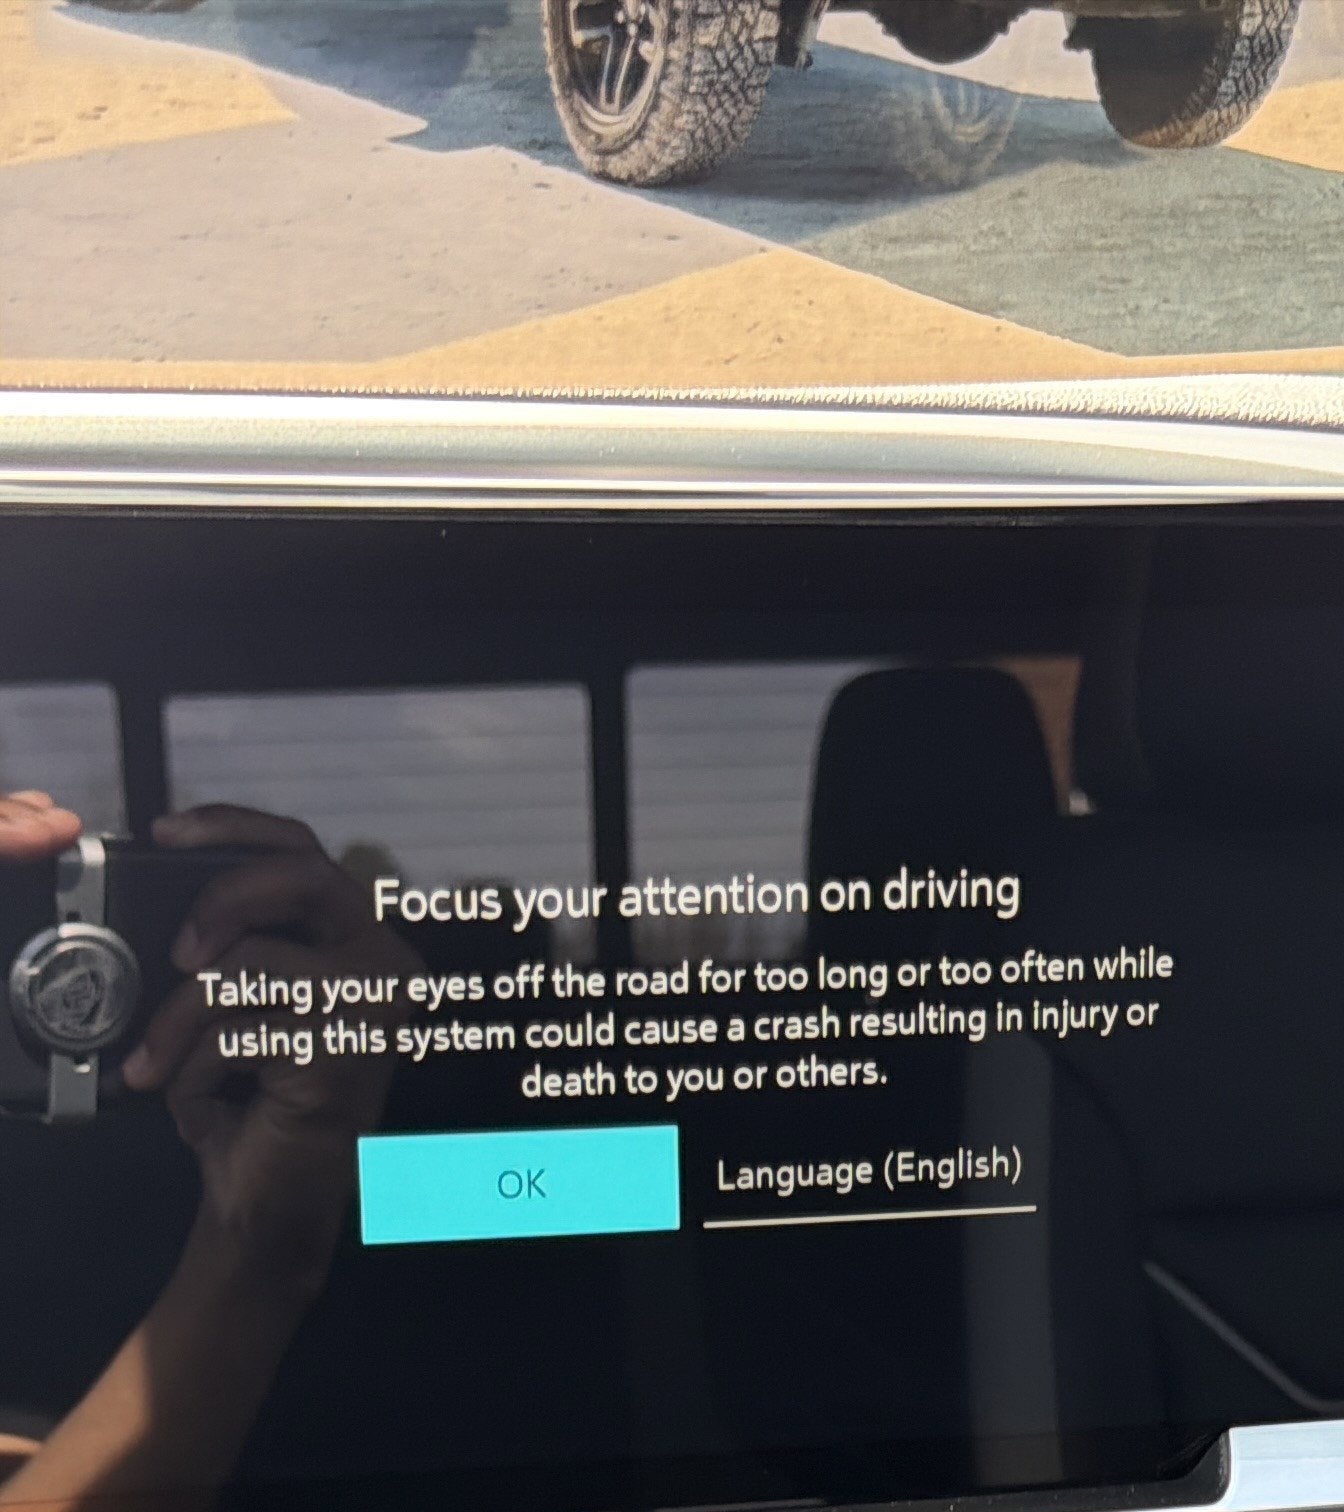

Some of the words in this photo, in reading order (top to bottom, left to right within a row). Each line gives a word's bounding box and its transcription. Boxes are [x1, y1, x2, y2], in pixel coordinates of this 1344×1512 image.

[373, 878, 503, 922] Focus
[512, 886, 608, 933] your
[618, 873, 809, 917] attention
[820, 879, 872, 913] on
[883, 865, 1020, 920] driving
[196, 969, 313, 1015] Taking
[321, 977, 400, 1014] your
[406, 974, 485, 1012] eyes
[493, 962, 546, 1000] off
[550, 961, 606, 998] the
[616, 959, 689, 997] road
[698, 958, 747, 994] for
[753, 961, 809, 992] too
[818, 955, 889, 998] long
[896, 962, 932, 987] or
[938, 955, 993, 986] too
[1000, 948, 1085, 984] often
[1092, 944, 1174, 981] while
[218, 1023, 314, 1066] using
[322, 1018, 387, 1055] this
[396, 1019, 516, 1063] system
[524, 1011, 615, 1049] could
[624, 1018, 718, 1046] cause
[726, 1017, 746, 1042] a
[753, 1004, 841, 1041] crash
[849, 1000, 987, 1043] resulting
[996, 1001, 1023, 1033] in
[1033, 998, 1119, 1039] injury
[1126, 1002, 1160, 1027] or
[521, 1060, 616, 1098] death
[623, 1063, 659, 1095] to
[665, 1066, 724, 1103] you
[732, 1065, 769, 1090] or
[775, 1053, 888, 1089] others.
[498, 1168, 547, 1199] OK
[717, 1159, 874, 1198] Language
[883, 1144, 1022, 1192] (English)
